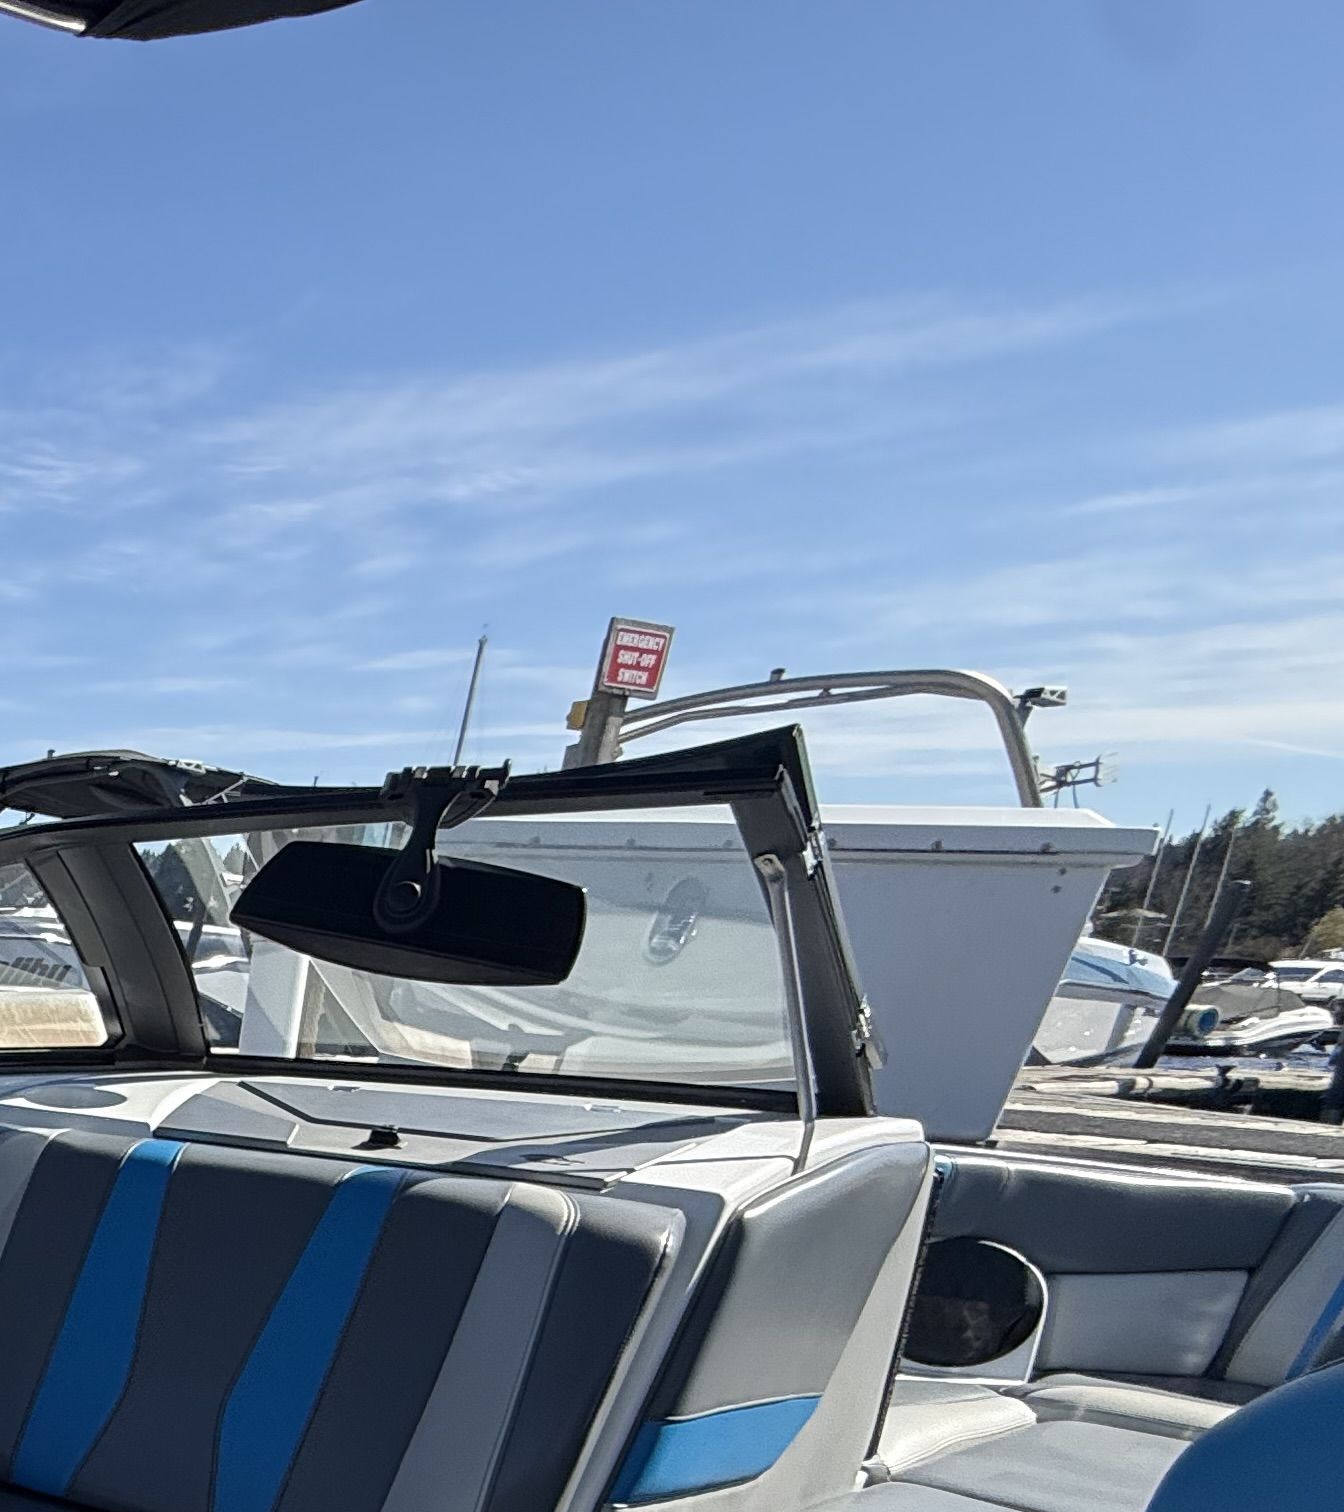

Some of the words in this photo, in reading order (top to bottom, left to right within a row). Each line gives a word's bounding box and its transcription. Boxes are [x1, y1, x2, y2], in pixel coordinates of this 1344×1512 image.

[617, 631, 665, 651] EMERGENCY
[617, 650, 658, 668] SHUT-OFF
[617, 669, 649, 685] SWITCH
